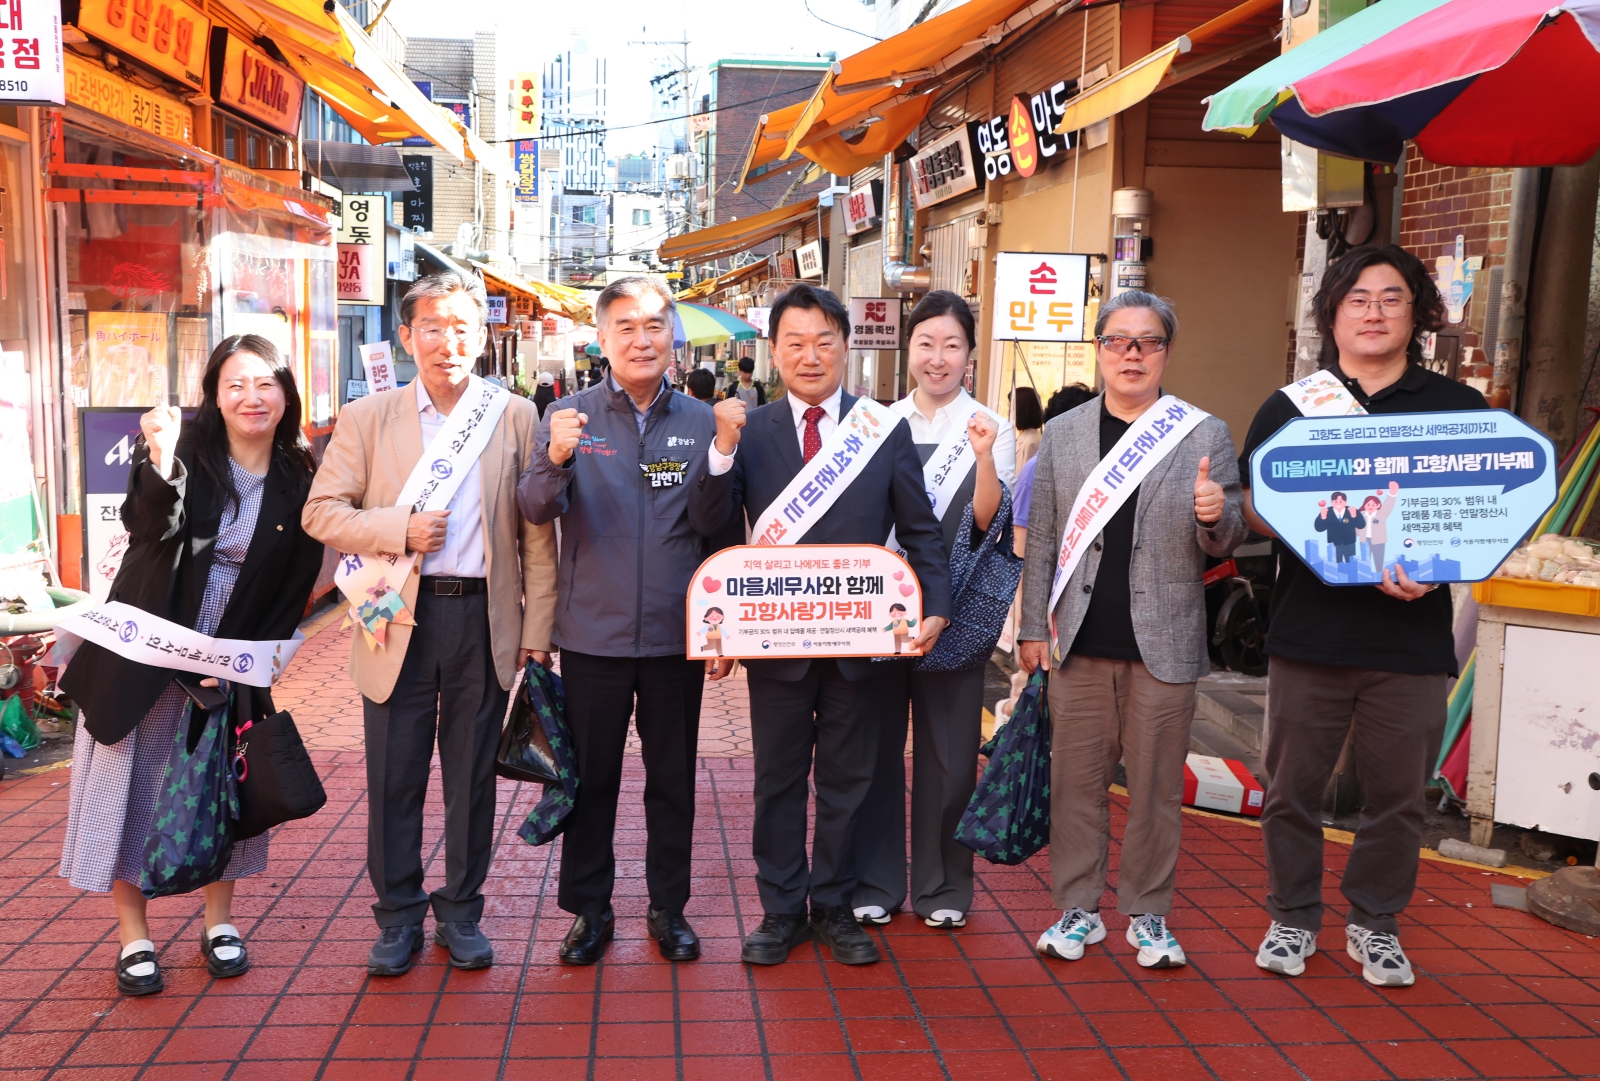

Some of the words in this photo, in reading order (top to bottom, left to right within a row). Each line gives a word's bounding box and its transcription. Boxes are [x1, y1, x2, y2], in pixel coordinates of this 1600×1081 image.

[0, 38, 40, 69] 점
[66, 69, 125, 120] 고추방앗간
[133, 94, 162, 135] 참기름
[349, 200, 371, 244] 영동
[340, 251, 360, 265] JA
[338, 266, 360, 279] JA
[1029, 262, 1058, 295] 손
[1009, 301, 1074, 333] 만두
[95, 330, 161, 342] 角ハイボール
[854, 325, 896, 335] 영동족반
[448, 390, 493, 455] 한국세무사회
[1309, 428, 1342, 441] 고향도
[1343, 426, 1377, 439] 살리고
[1379, 424, 1424, 438] 연말정산
[1425, 421, 1497, 436] 세액공제까지!
[678, 438, 696, 446] 강남구
[1103, 403, 1188, 490] 추석준비는
[648, 462, 681, 473] 강남구청장
[931, 428, 971, 487] 국세무사회
[1272, 457, 1372, 478] 마을세무사와
[1374, 455, 1409, 476] 함께
[1412, 451, 1534, 473] 고향사랑기부제
[649, 471, 683, 487] 김현기
[783, 433, 864, 524] 추석준비는
[1401, 497, 1439, 508] 기부금의
[1441, 497, 1462, 506] 30%
[1465, 496, 1485, 506] 범위
[1487, 495, 1497, 505] 내
[1401, 510, 1430, 521] 답례품
[1432, 509, 1452, 520] 제공
[1459, 507, 1508, 519] 연말정산시
[1060, 487, 1109, 568] 전통시장
[1401, 522, 1441, 533] 세액공제
[1443, 521, 1463, 532] 혜택
[743, 560, 762, 570] 지역
[764, 559, 792, 570] 살리고
[794, 559, 830, 570] 나에게도
[832, 559, 851, 570] 좋은
[853, 559, 871, 569] 기부
[726, 576, 840, 596] 마을세무사와
[846, 575, 884, 595] 함께
[738, 601, 872, 622] 고향사랑기부제
[145, 633, 231, 667] 한국세무사회
